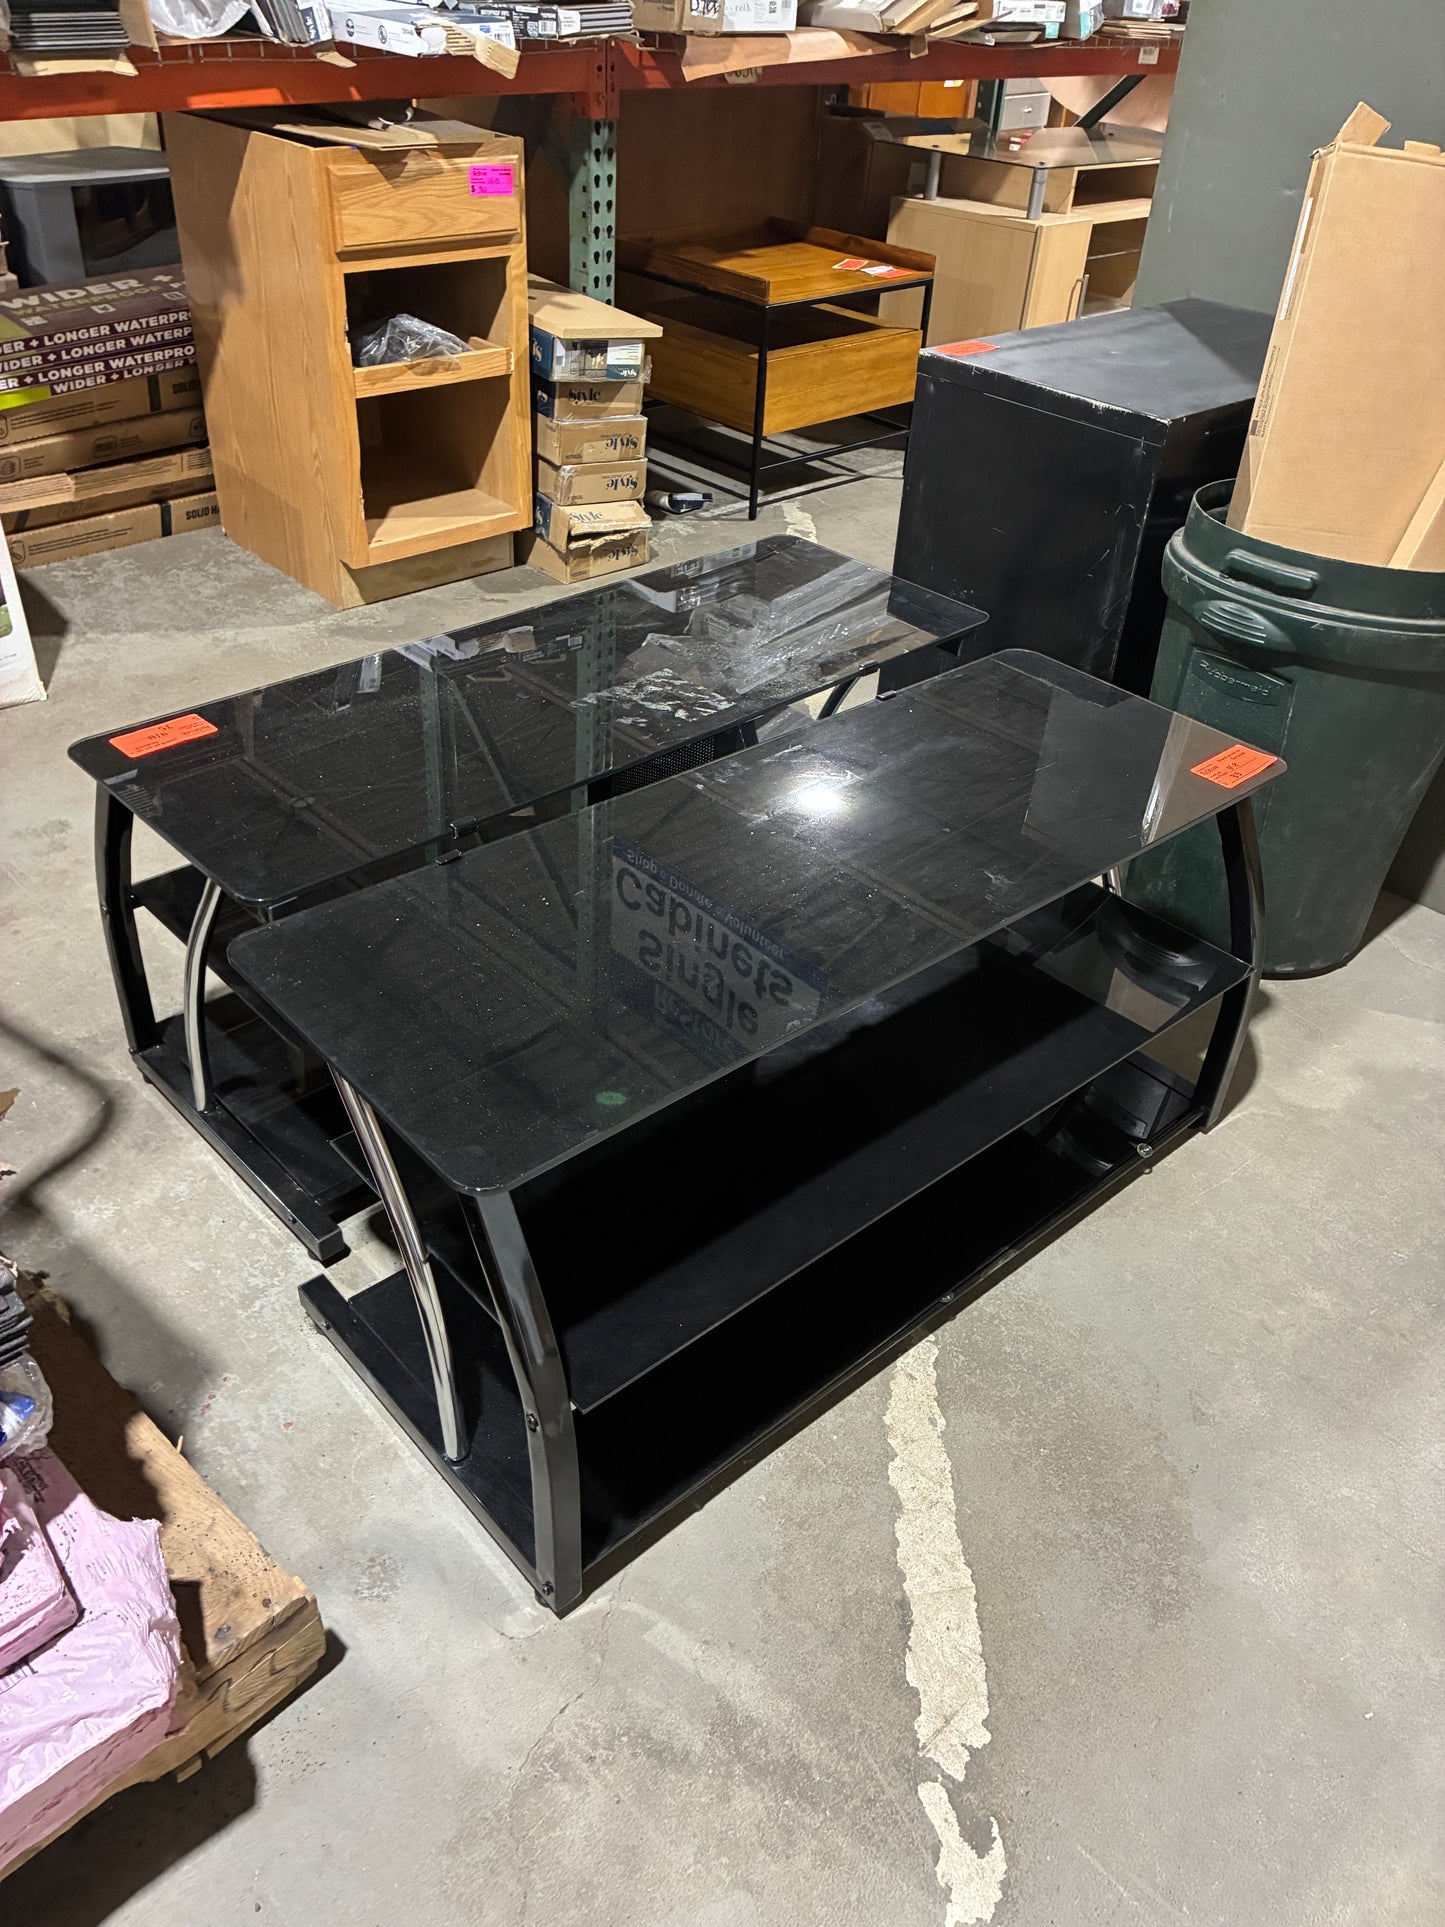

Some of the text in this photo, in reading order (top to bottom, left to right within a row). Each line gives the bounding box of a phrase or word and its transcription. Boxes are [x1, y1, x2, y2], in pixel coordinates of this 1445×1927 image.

[0, 278, 144, 310] WIDER
[43, 324, 111, 347] LONGER
[61, 338, 126, 360] LONGER
[38, 361, 106, 383] LONGER
[108, 345, 195, 369] WATERPRO
[52, 373, 106, 394] WIDER
[123, 359, 185, 379] LONGER
[568, 387, 602, 404] Style
[605, 433, 639, 450] Style
[606, 473, 639, 490] Style
[186, 506, 210, 520] SOLID
